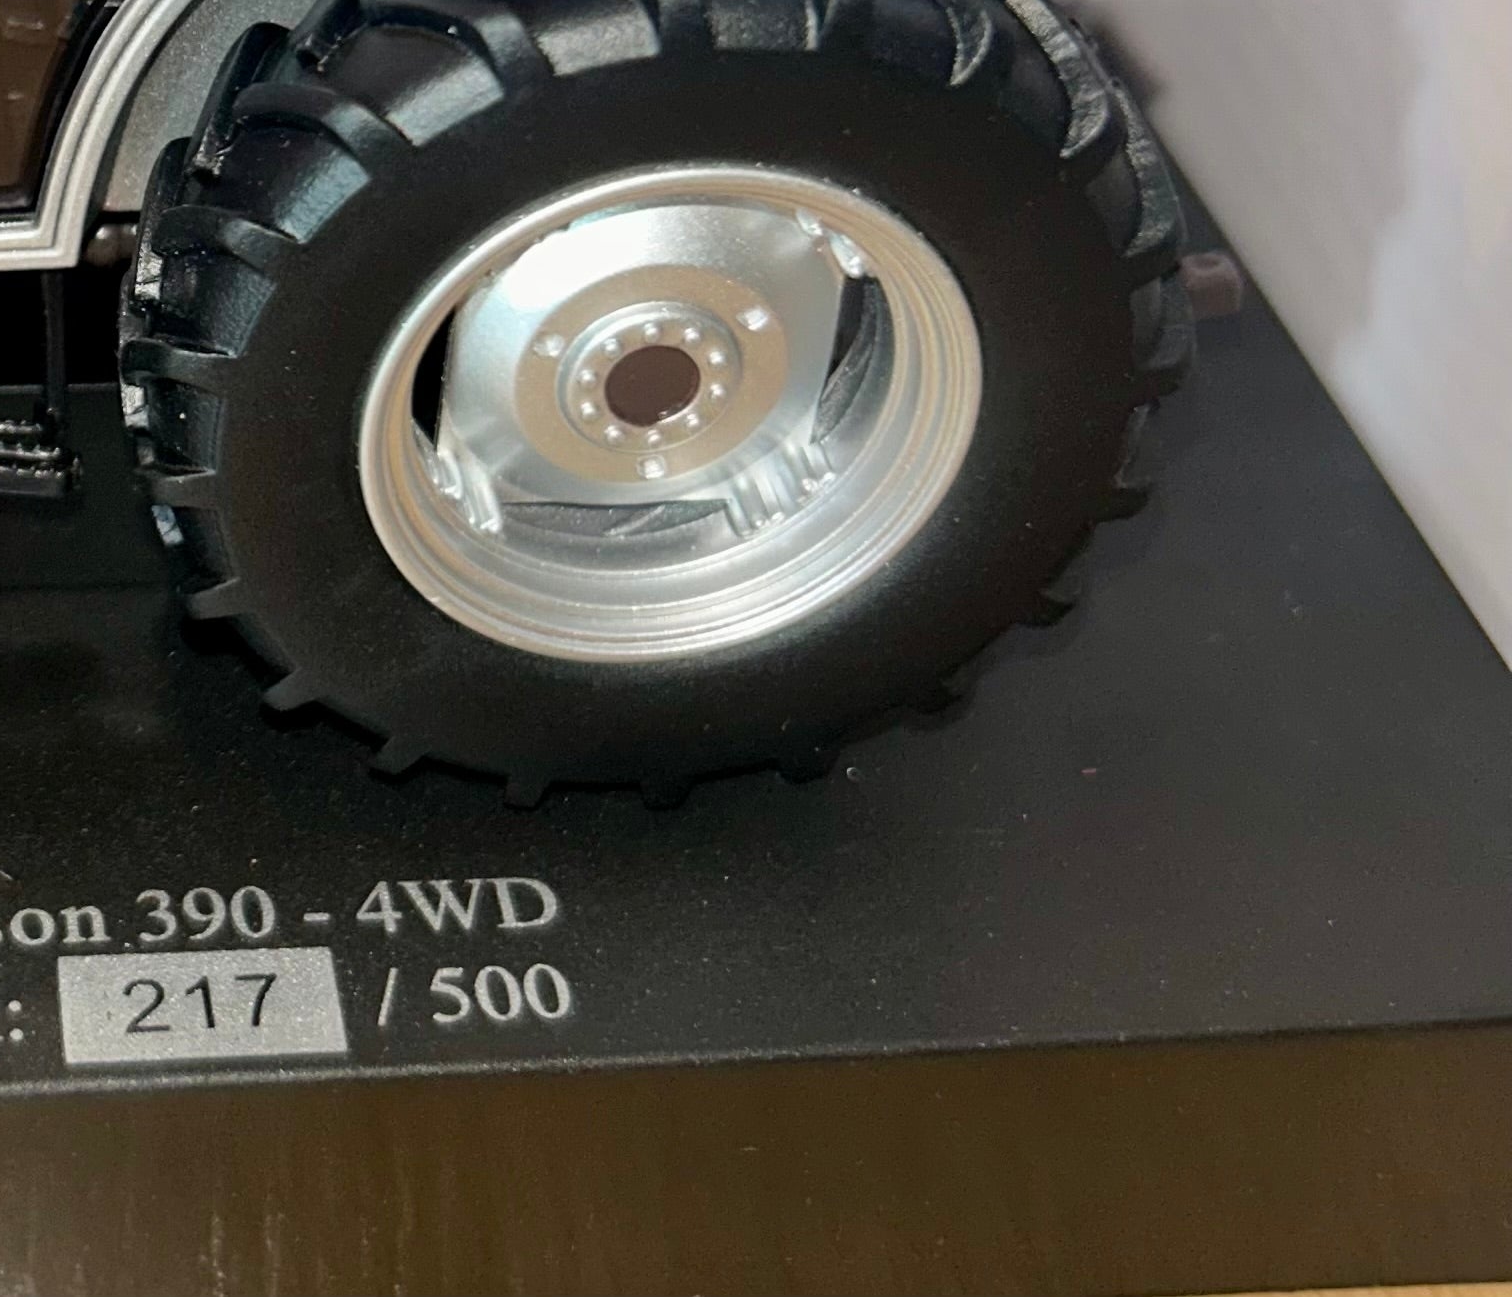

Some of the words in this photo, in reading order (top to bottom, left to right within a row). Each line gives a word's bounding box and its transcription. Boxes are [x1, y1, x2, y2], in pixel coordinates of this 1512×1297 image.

[135, 885, 277, 943] 390
[356, 876, 559, 935] 4WD
[122, 971, 279, 1034] 217
[430, 962, 571, 1025] 500
